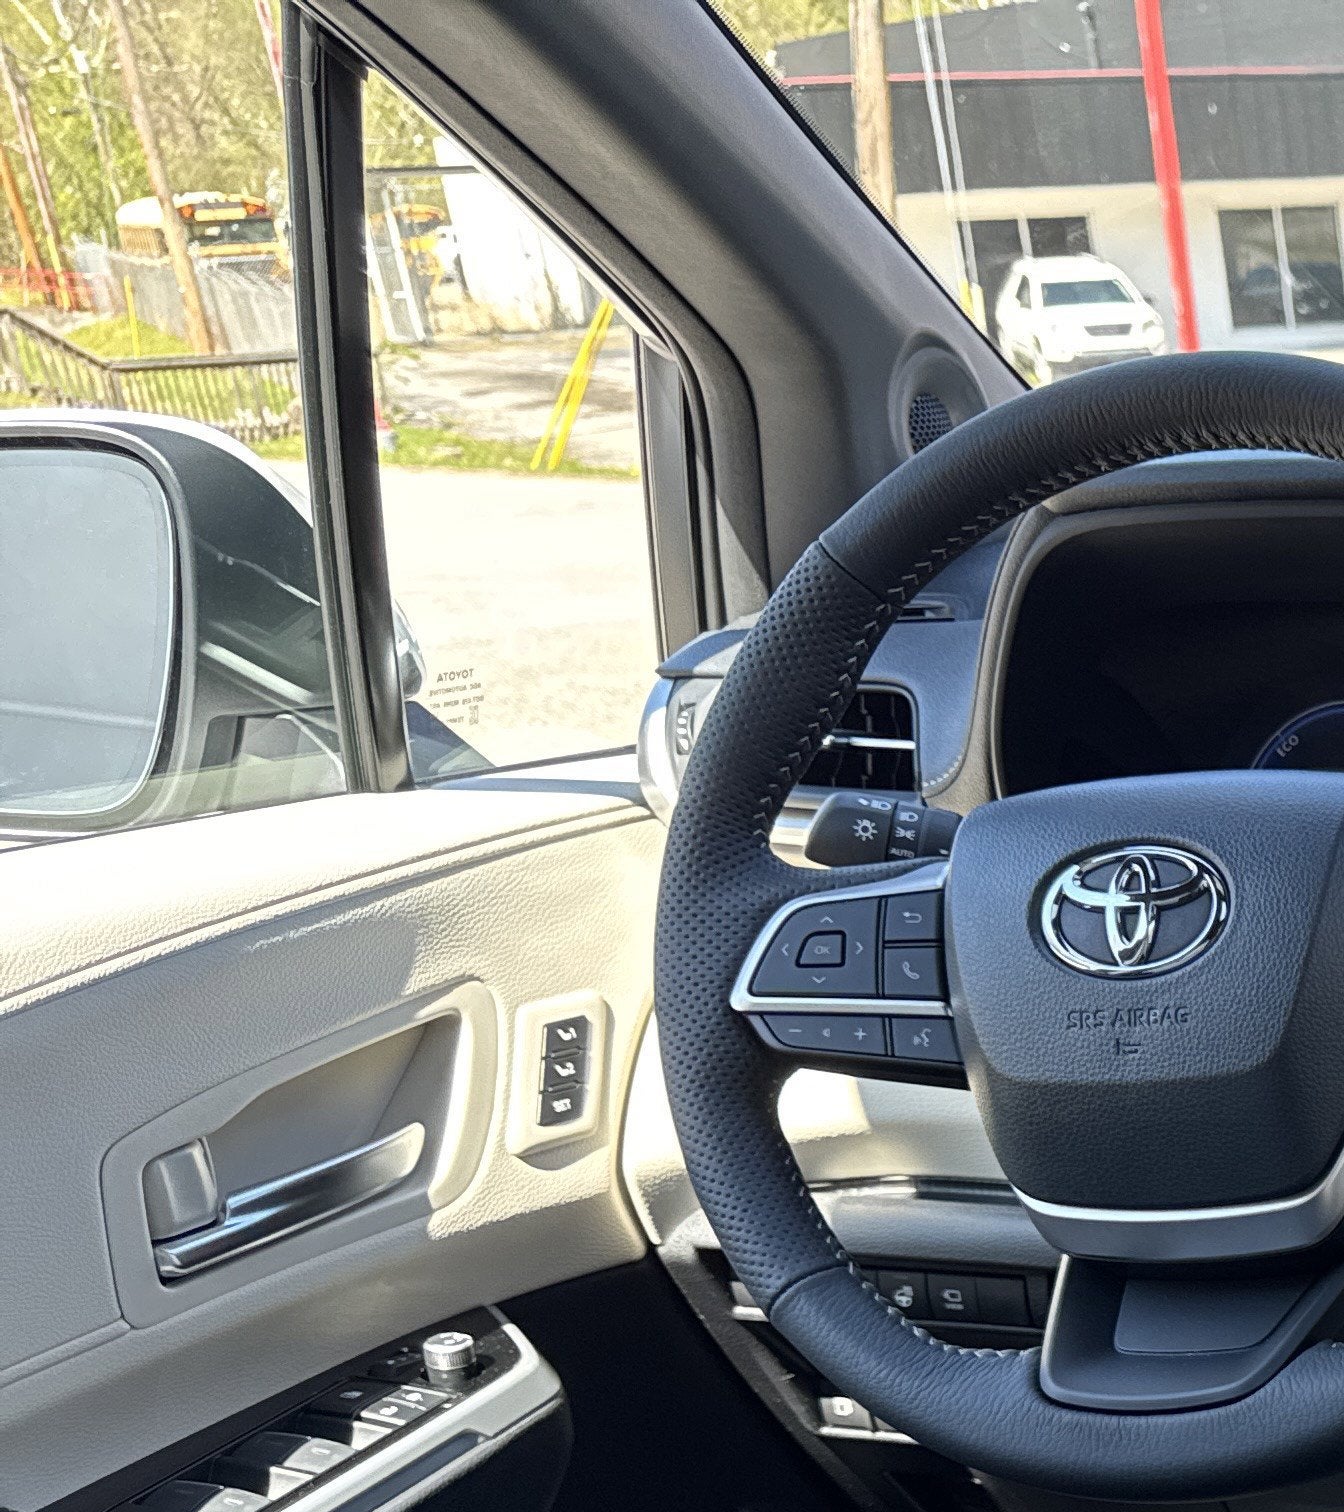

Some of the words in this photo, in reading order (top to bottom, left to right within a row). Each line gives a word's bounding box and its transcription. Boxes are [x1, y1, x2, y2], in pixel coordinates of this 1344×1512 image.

[1276, 734, 1300, 758] ECO
[814, 945, 831, 955] OK
[1066, 1009, 1108, 1031] SRS
[1111, 1005, 1192, 1029] AIRBAG
